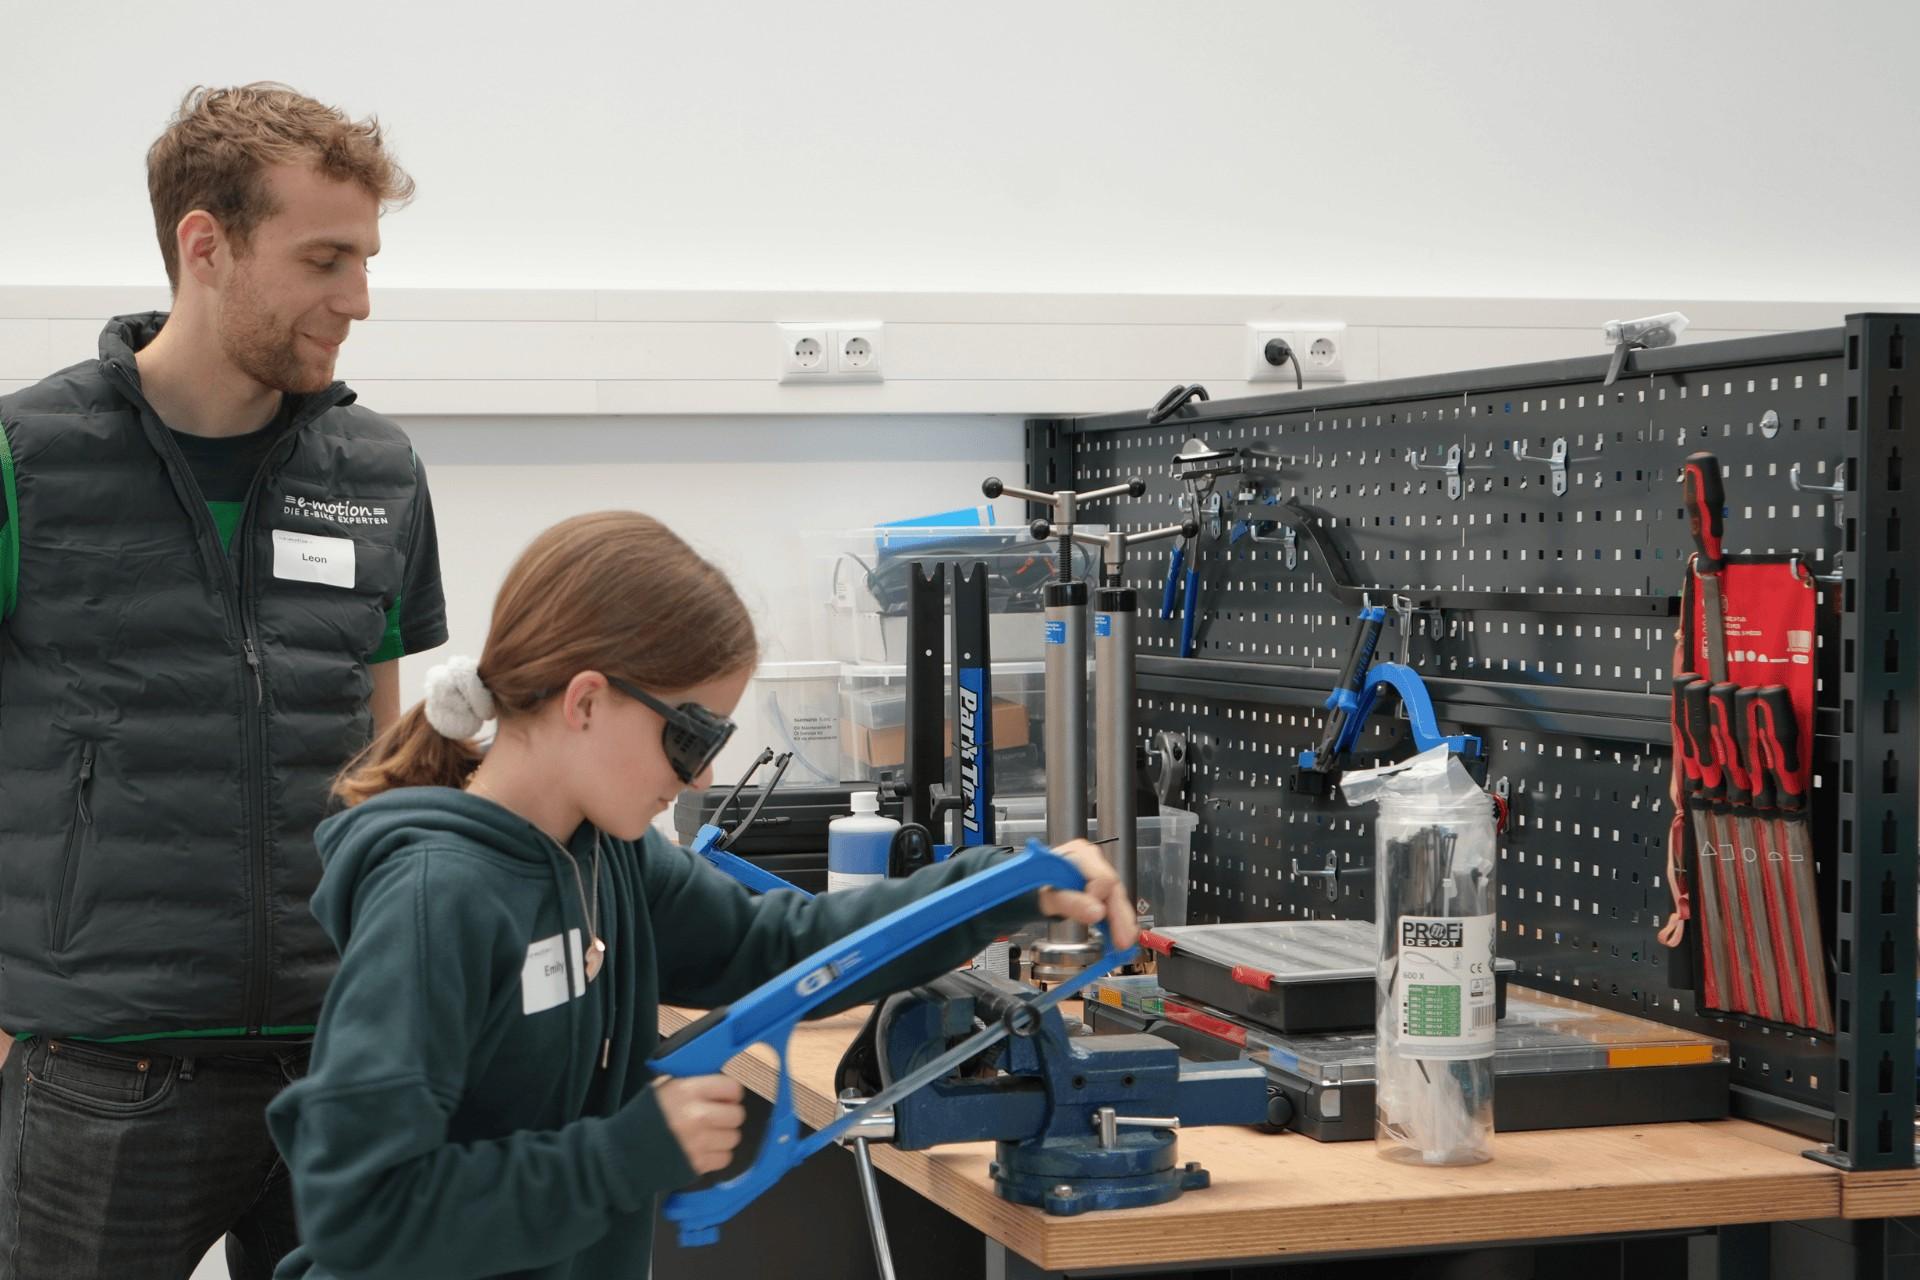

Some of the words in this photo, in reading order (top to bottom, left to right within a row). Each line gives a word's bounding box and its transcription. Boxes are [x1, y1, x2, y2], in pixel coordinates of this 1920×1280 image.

[283, 506, 300, 516] DIE
[303, 509, 335, 521] E-BIKE
[337, 515, 388, 525] EXPERTEN
[297, 496, 372, 517] e-motion
[302, 552, 328, 564] Leon
[960, 687, 978, 762] Park
[1405, 938, 1460, 948] DEPOT
